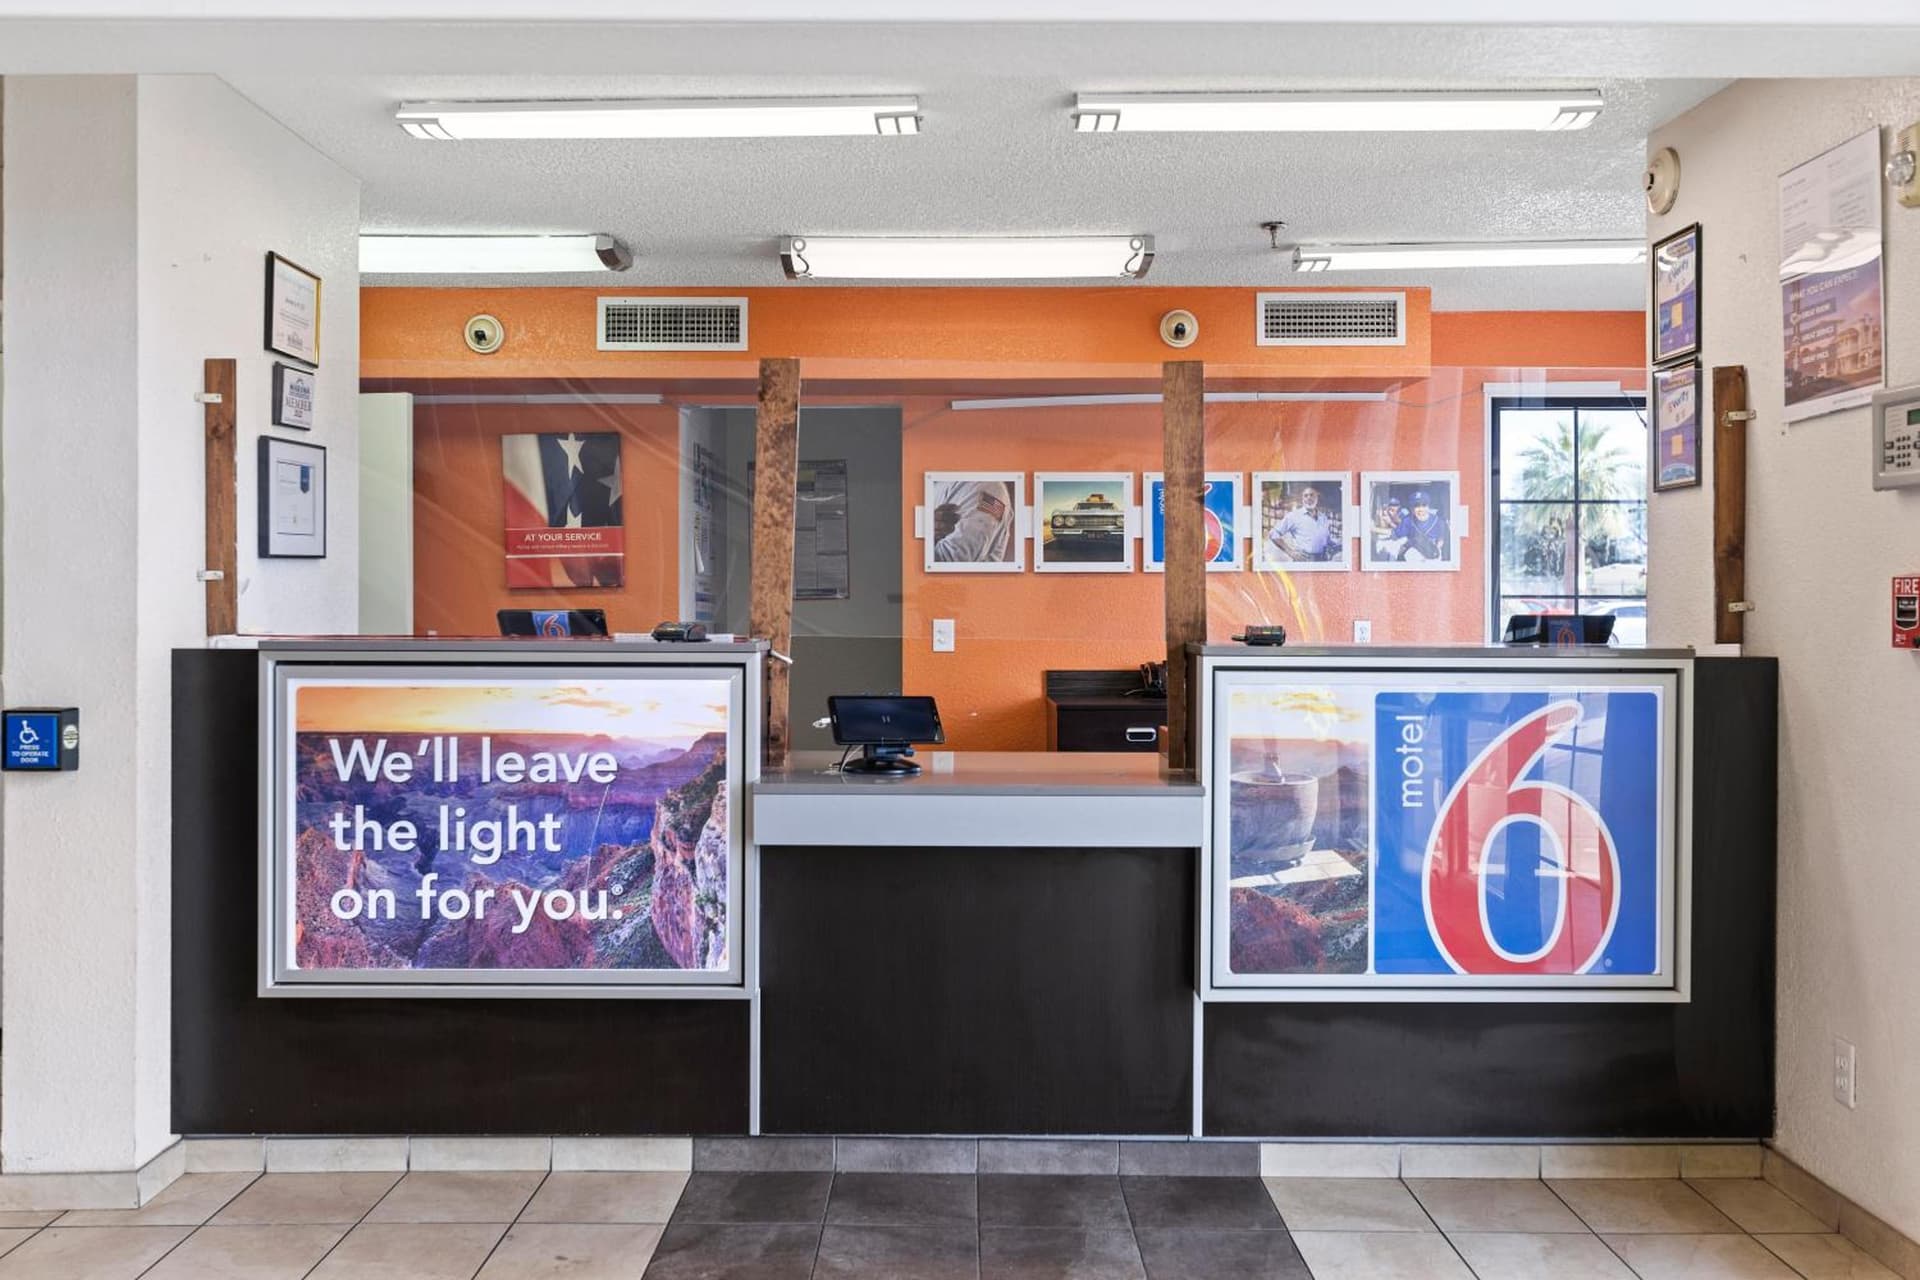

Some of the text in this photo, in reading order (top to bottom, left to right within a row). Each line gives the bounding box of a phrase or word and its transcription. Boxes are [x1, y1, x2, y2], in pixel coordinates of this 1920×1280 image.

[525, 532, 601, 542] AT YOUR SERVICE
[1895, 579, 1919, 594] FIRE
[329, 737, 618, 783] We'll leave
[1396, 715, 1424, 807] motel
[329, 805, 562, 865] the light
[1422, 699, 1621, 975] 6
[330, 887, 395, 920] on
[416, 873, 495, 920] for
